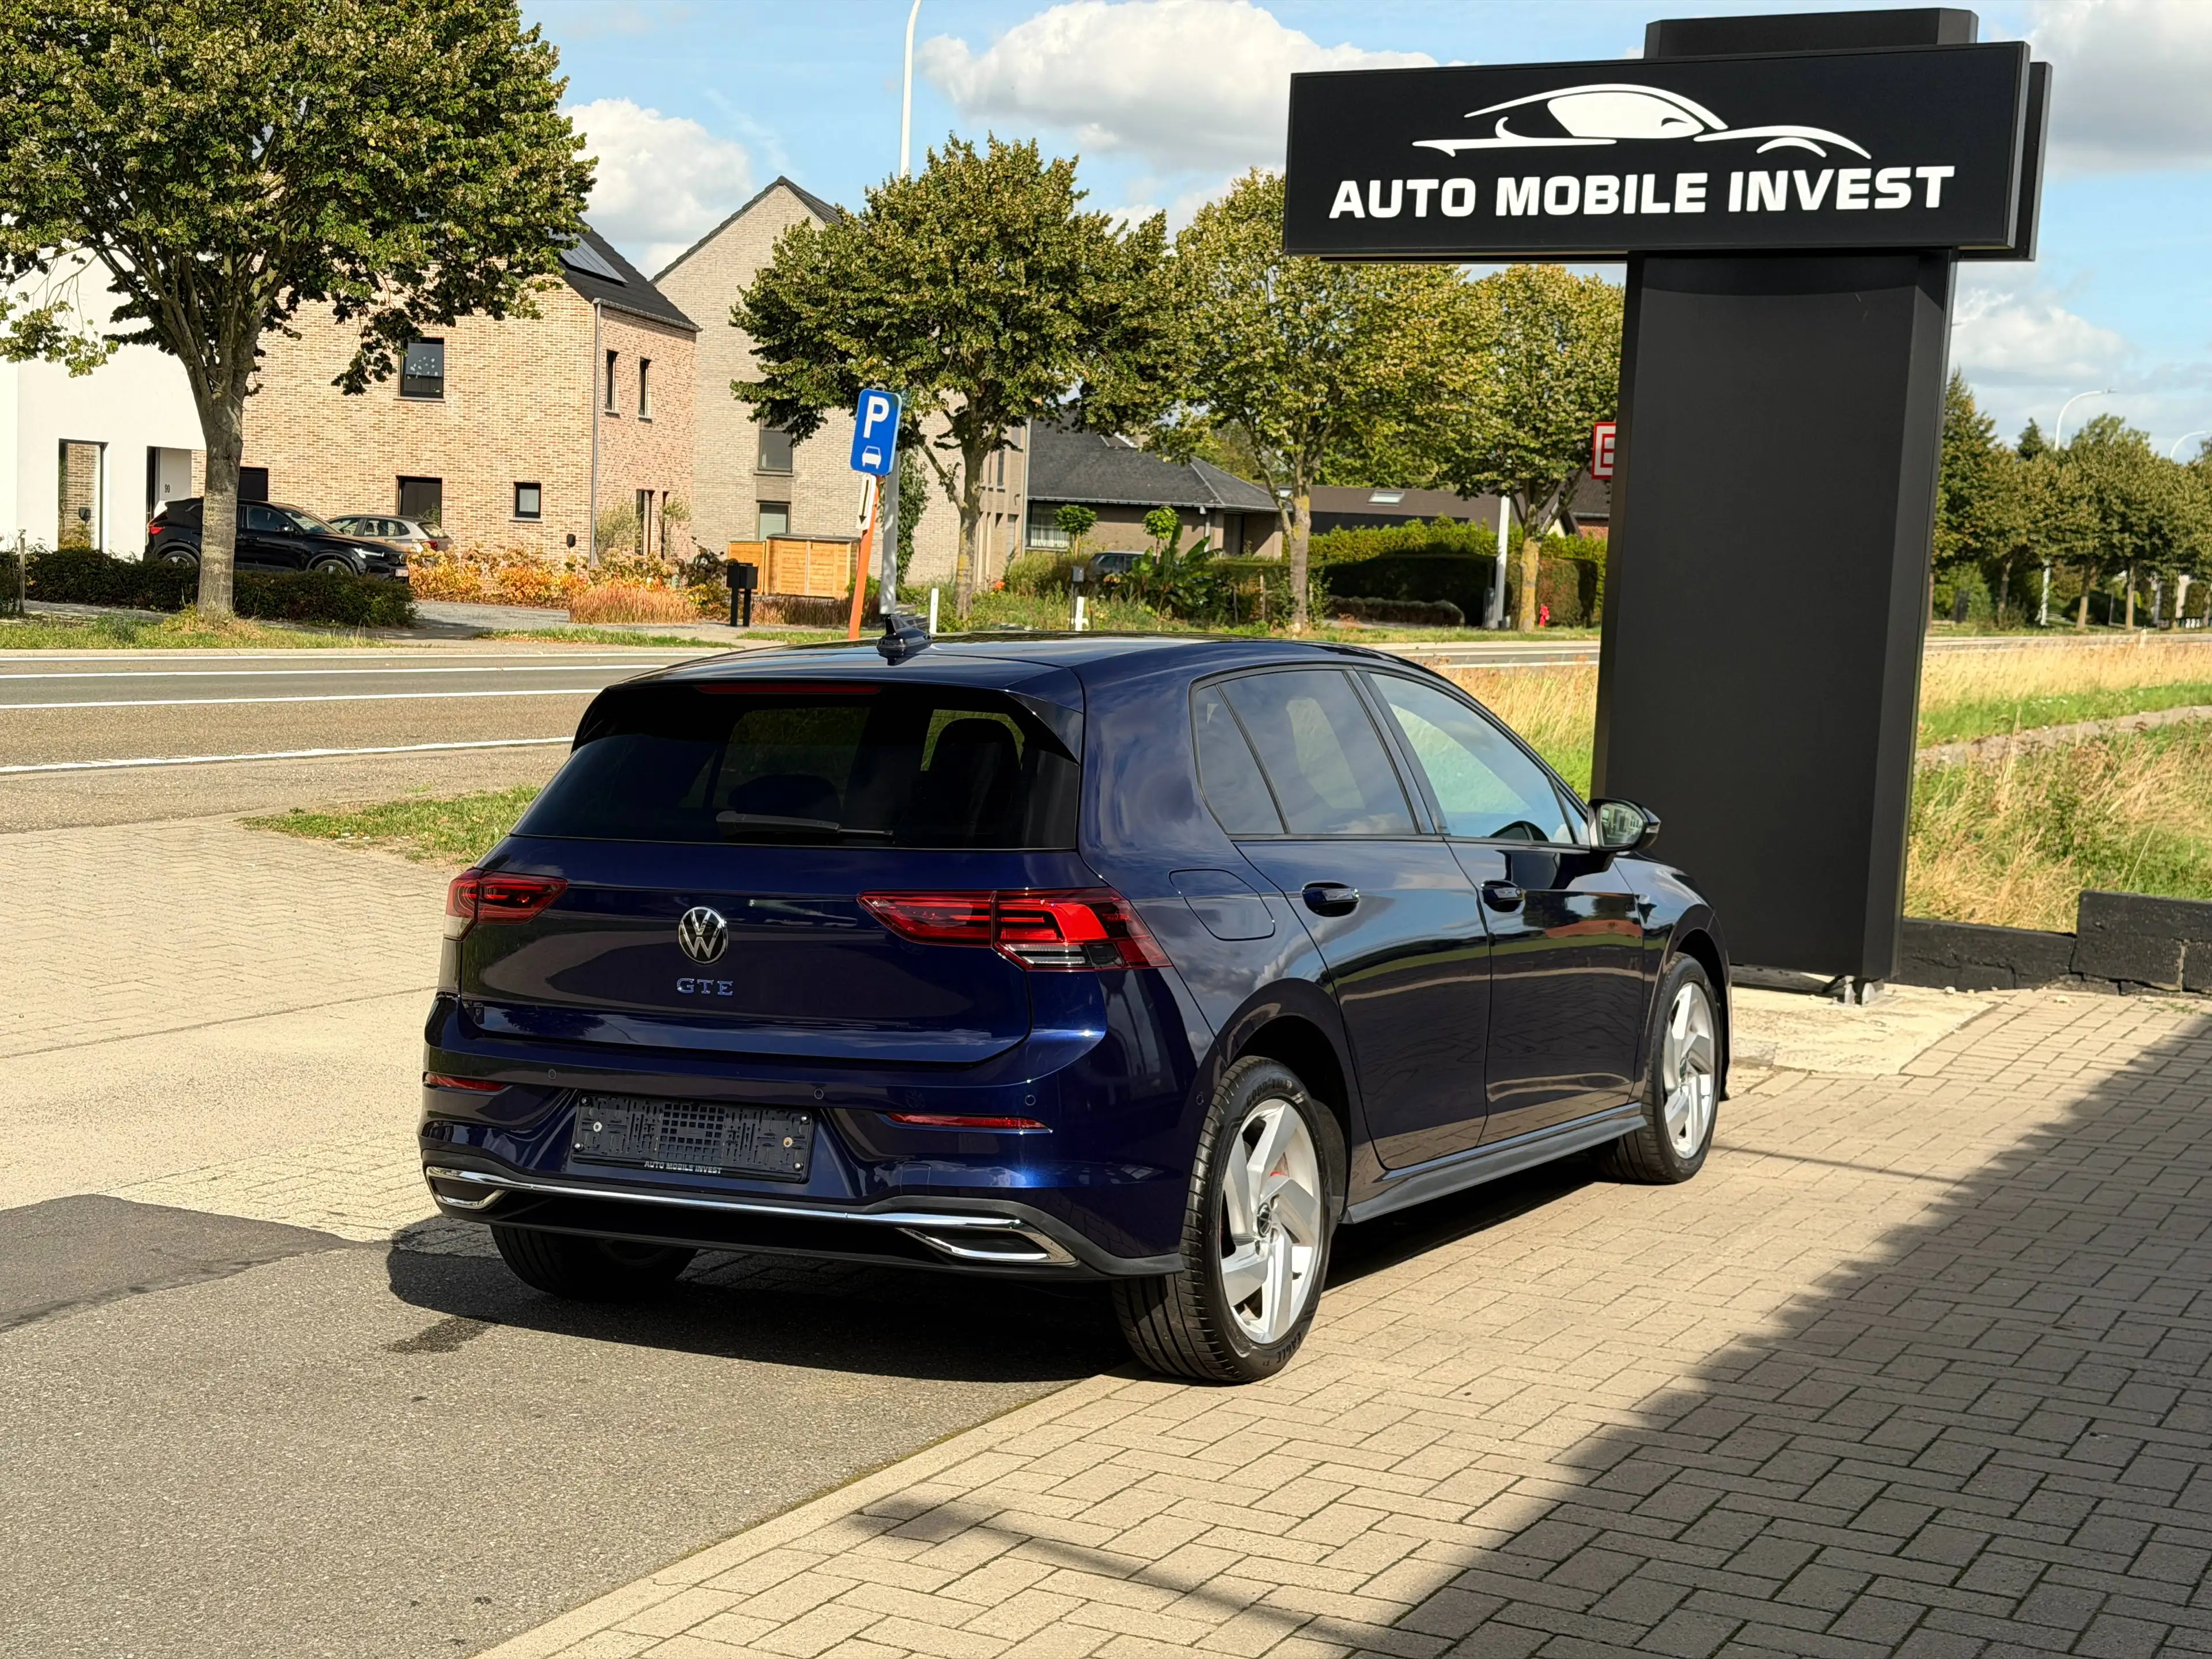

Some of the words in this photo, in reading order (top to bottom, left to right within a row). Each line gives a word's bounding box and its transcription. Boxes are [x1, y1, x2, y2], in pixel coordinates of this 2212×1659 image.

[1328, 177, 1477, 219] AUTO
[1495, 172, 1709, 217] MOBILE
[1728, 165, 1956, 213] INVEST
[863, 395, 889, 439] P
[676, 978, 733, 996] GTE
[645, 1161, 665, 1169] AUTO
[666, 1162, 694, 1171] MOBILE
[695, 1165, 722, 1174] INVEST
